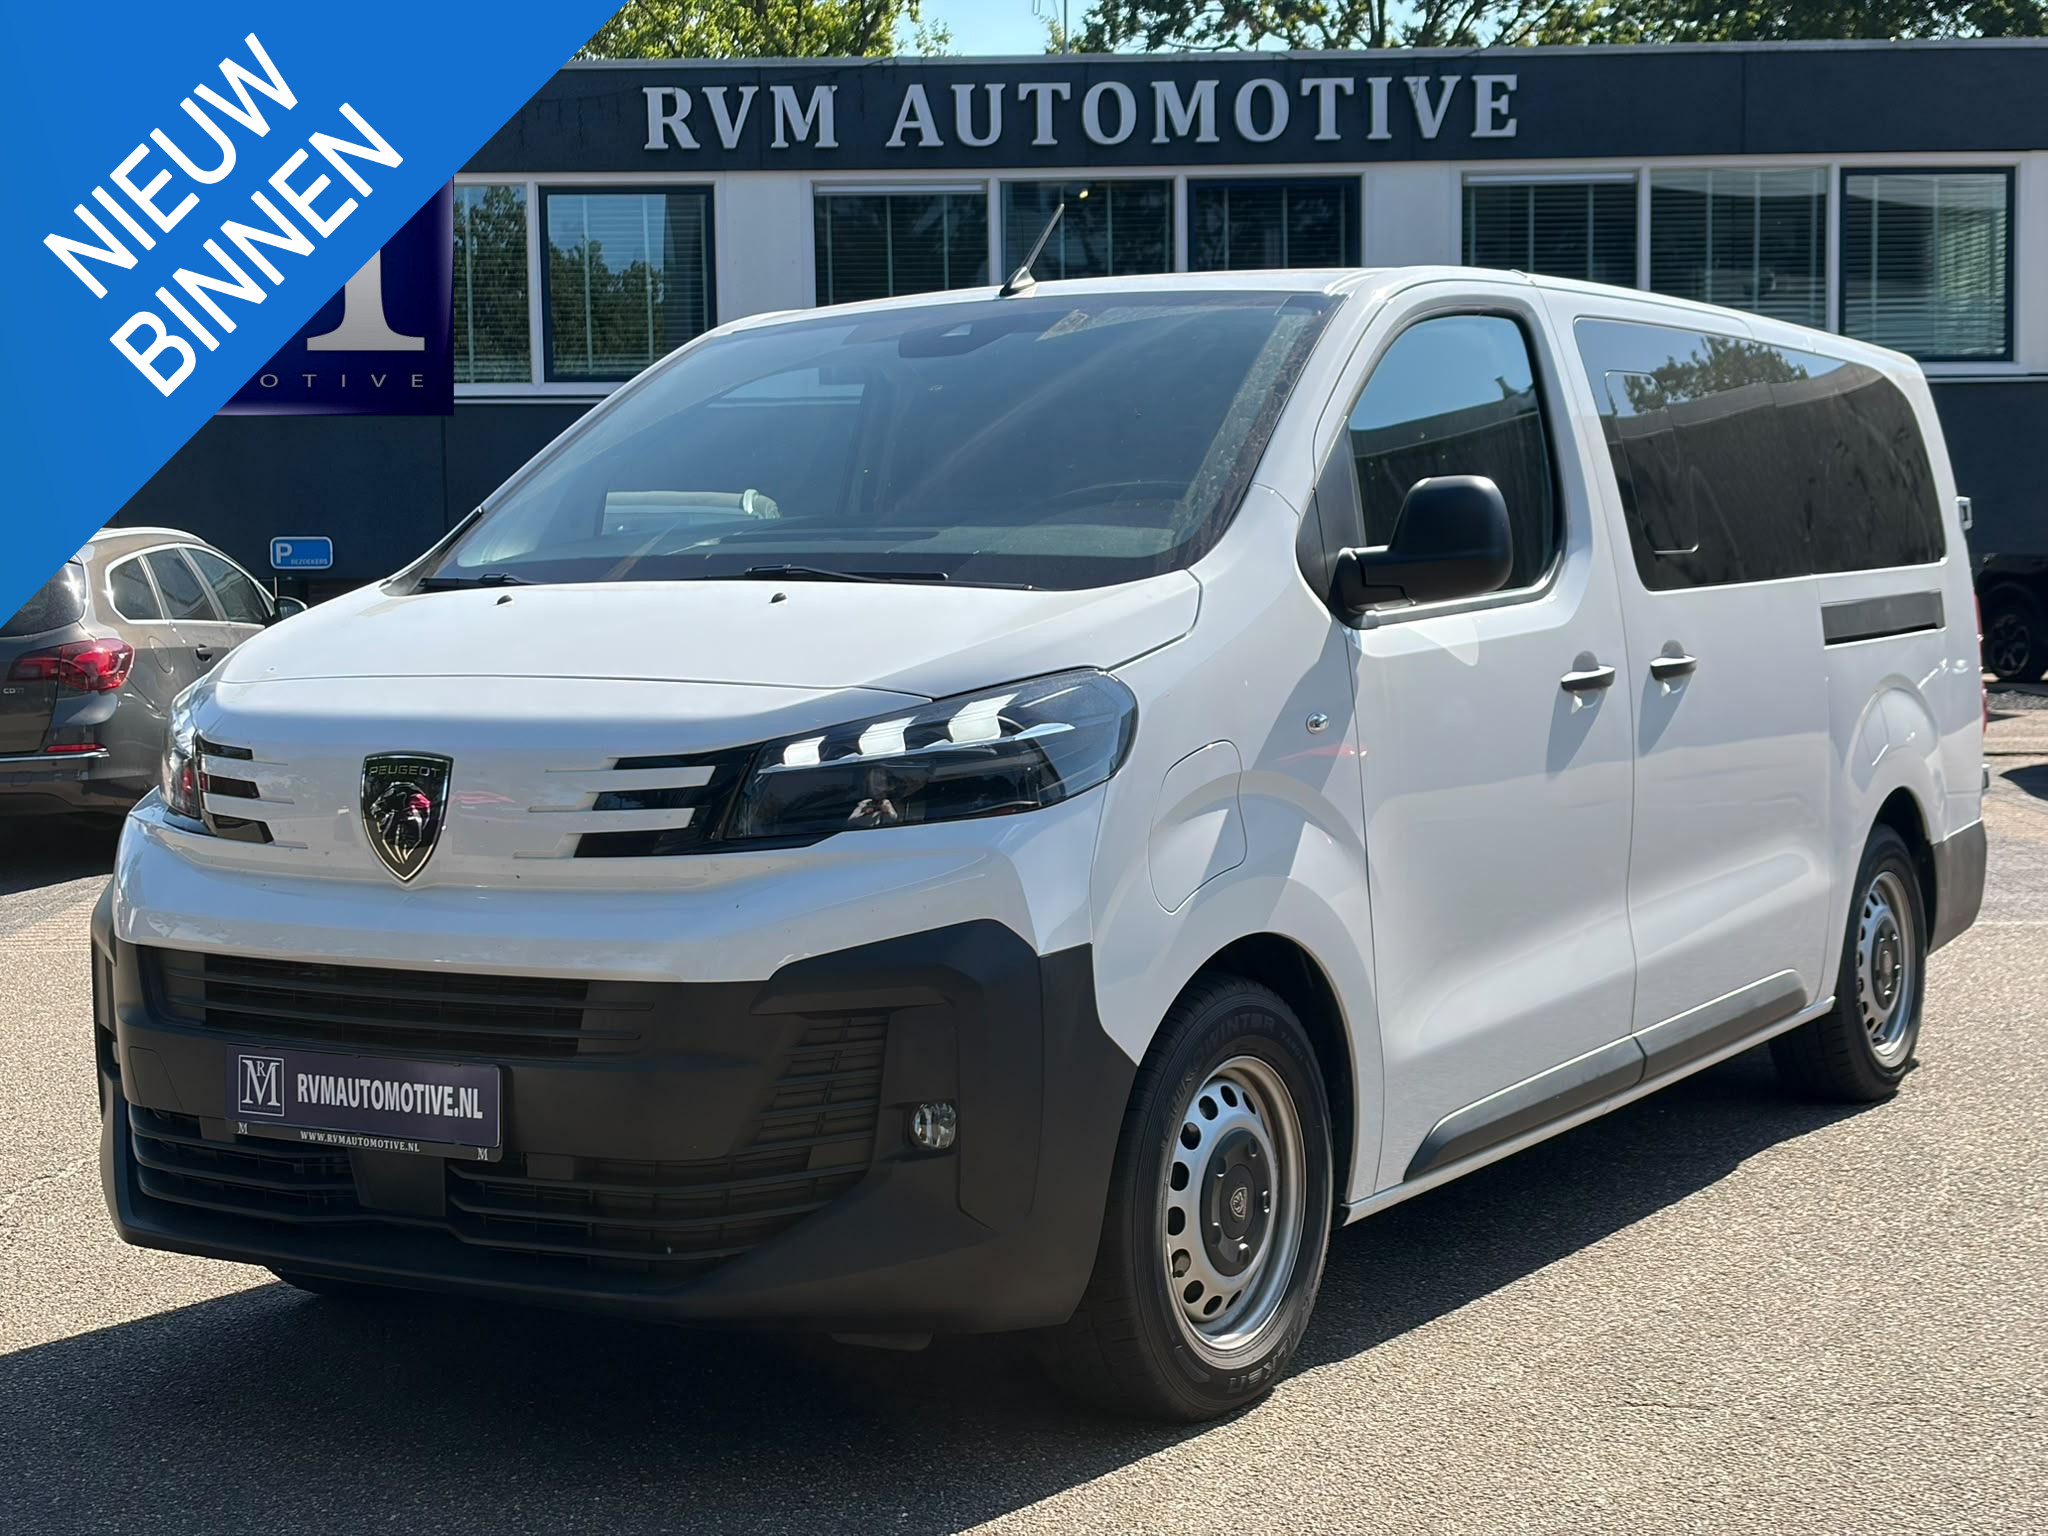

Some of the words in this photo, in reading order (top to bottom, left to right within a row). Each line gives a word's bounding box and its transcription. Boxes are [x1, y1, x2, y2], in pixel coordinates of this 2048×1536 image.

[642, 85, 839, 151] RVM
[885, 73, 1519, 148] AUTOMOTIVE
[275, 542, 293, 565] P
[368, 764, 441, 777] PEUGEOT
[297, 1073, 483, 1119] RVMAUTOMOTIVE.NL
[300, 1130, 421, 1153] WWW.RVMAUTOMOTIVE.NL
